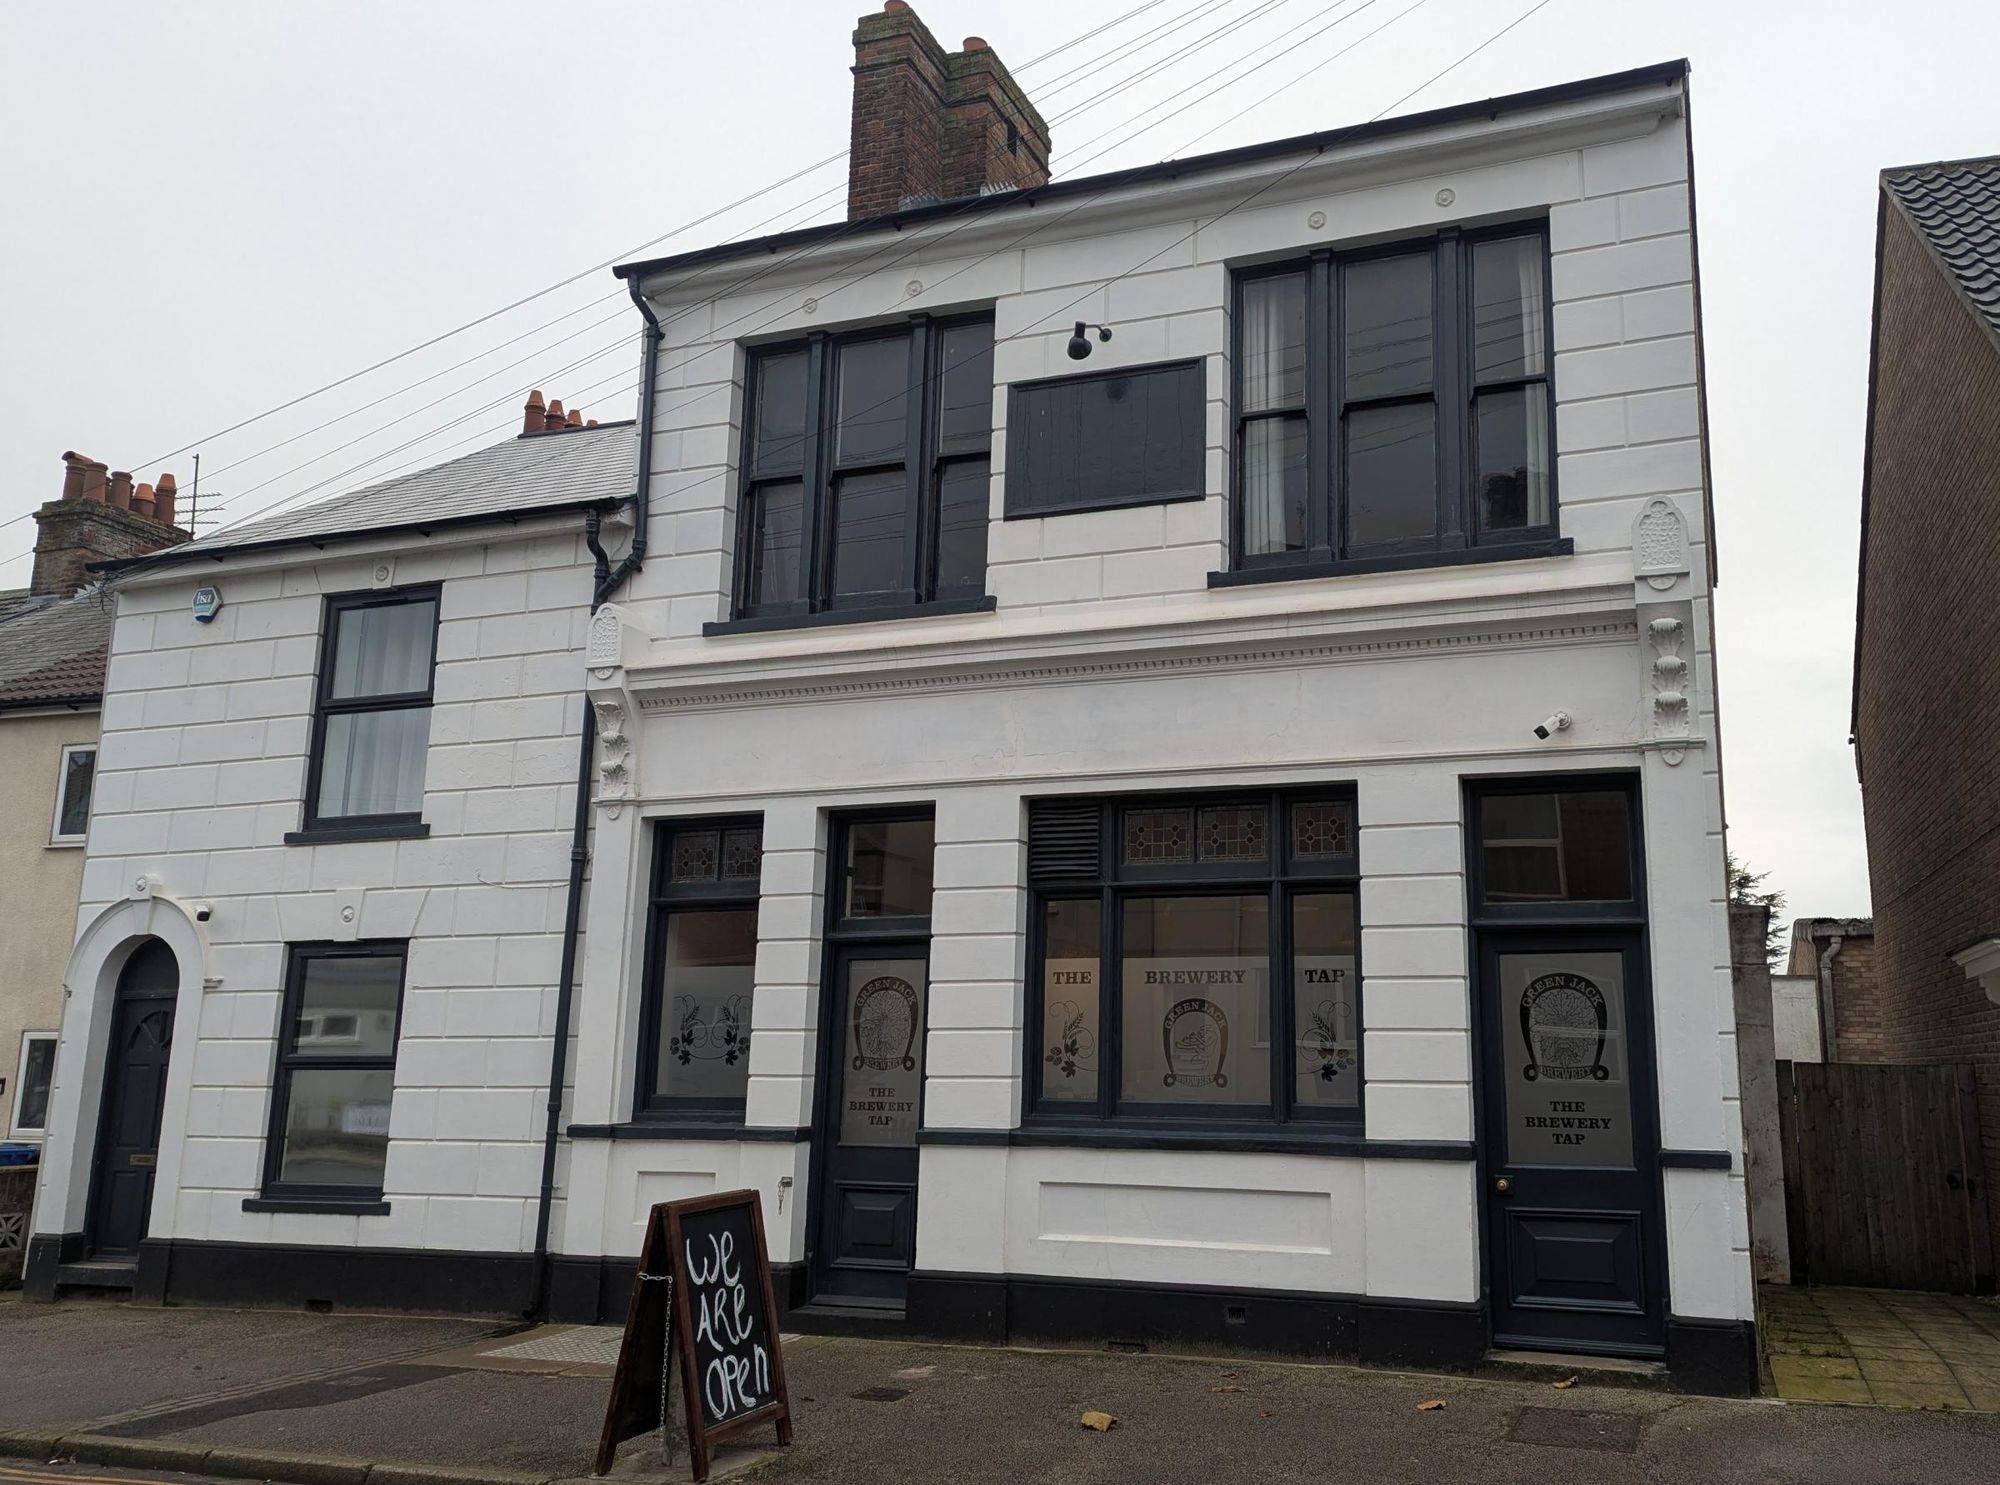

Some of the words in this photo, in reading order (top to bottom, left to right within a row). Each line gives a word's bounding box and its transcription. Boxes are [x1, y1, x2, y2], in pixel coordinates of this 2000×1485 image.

[1053, 971, 1092, 985] THE
[1144, 970, 1247, 985] BREWERY
[1305, 969, 1345, 983] TAP
[856, 979, 891, 1007] GREEN
[893, 979, 917, 1006] JACK
[1522, 976, 1565, 1008] GREEN
[1569, 976, 1604, 1008] JACK
[1165, 1001, 1200, 1029] GREEN
[1203, 1001, 1228, 1028] JACK
[1540, 1065, 1592, 1081] BREWERY
[869, 1087, 895, 1097] THE
[849, 1101, 914, 1112] BREWERY
[1550, 1101, 1585, 1112] THE
[868, 1116, 893, 1126] TAP
[1525, 1116, 1612, 1129] BREWERY
[1552, 1133, 1586, 1145] TAP
